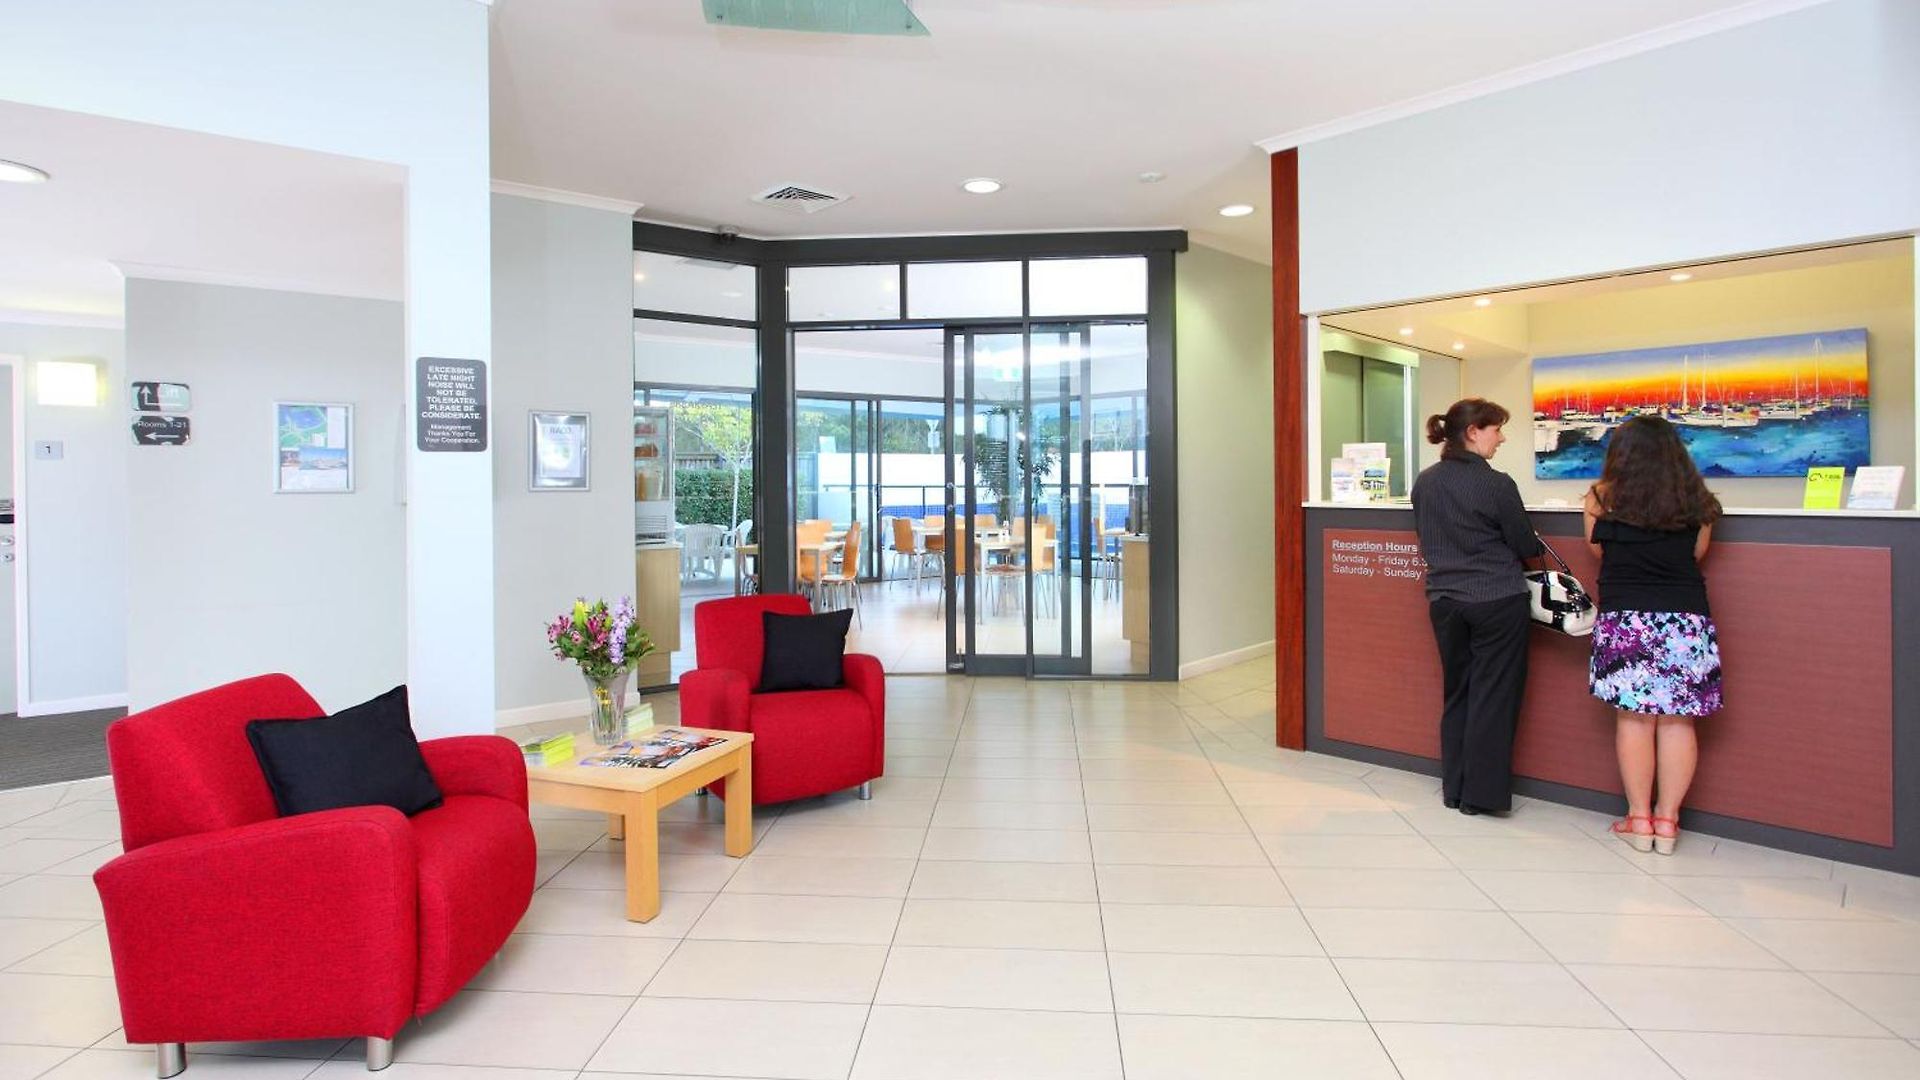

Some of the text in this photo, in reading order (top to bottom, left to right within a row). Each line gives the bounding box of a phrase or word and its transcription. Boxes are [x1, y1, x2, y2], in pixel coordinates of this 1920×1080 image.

[428, 366, 475, 375] EXCESSIVE
[455, 382, 476, 390] WILL
[436, 389, 454, 397] NOT
[429, 404, 462, 412] PLEASE
[137, 421, 167, 429] Rooms
[1332, 540, 1418, 553] Reception Hours
[1332, 553, 1369, 564] Monday
[1378, 555, 1409, 567] Friday
[1332, 564, 1374, 576] Saturday
[1384, 568, 1422, 580] Sunday
